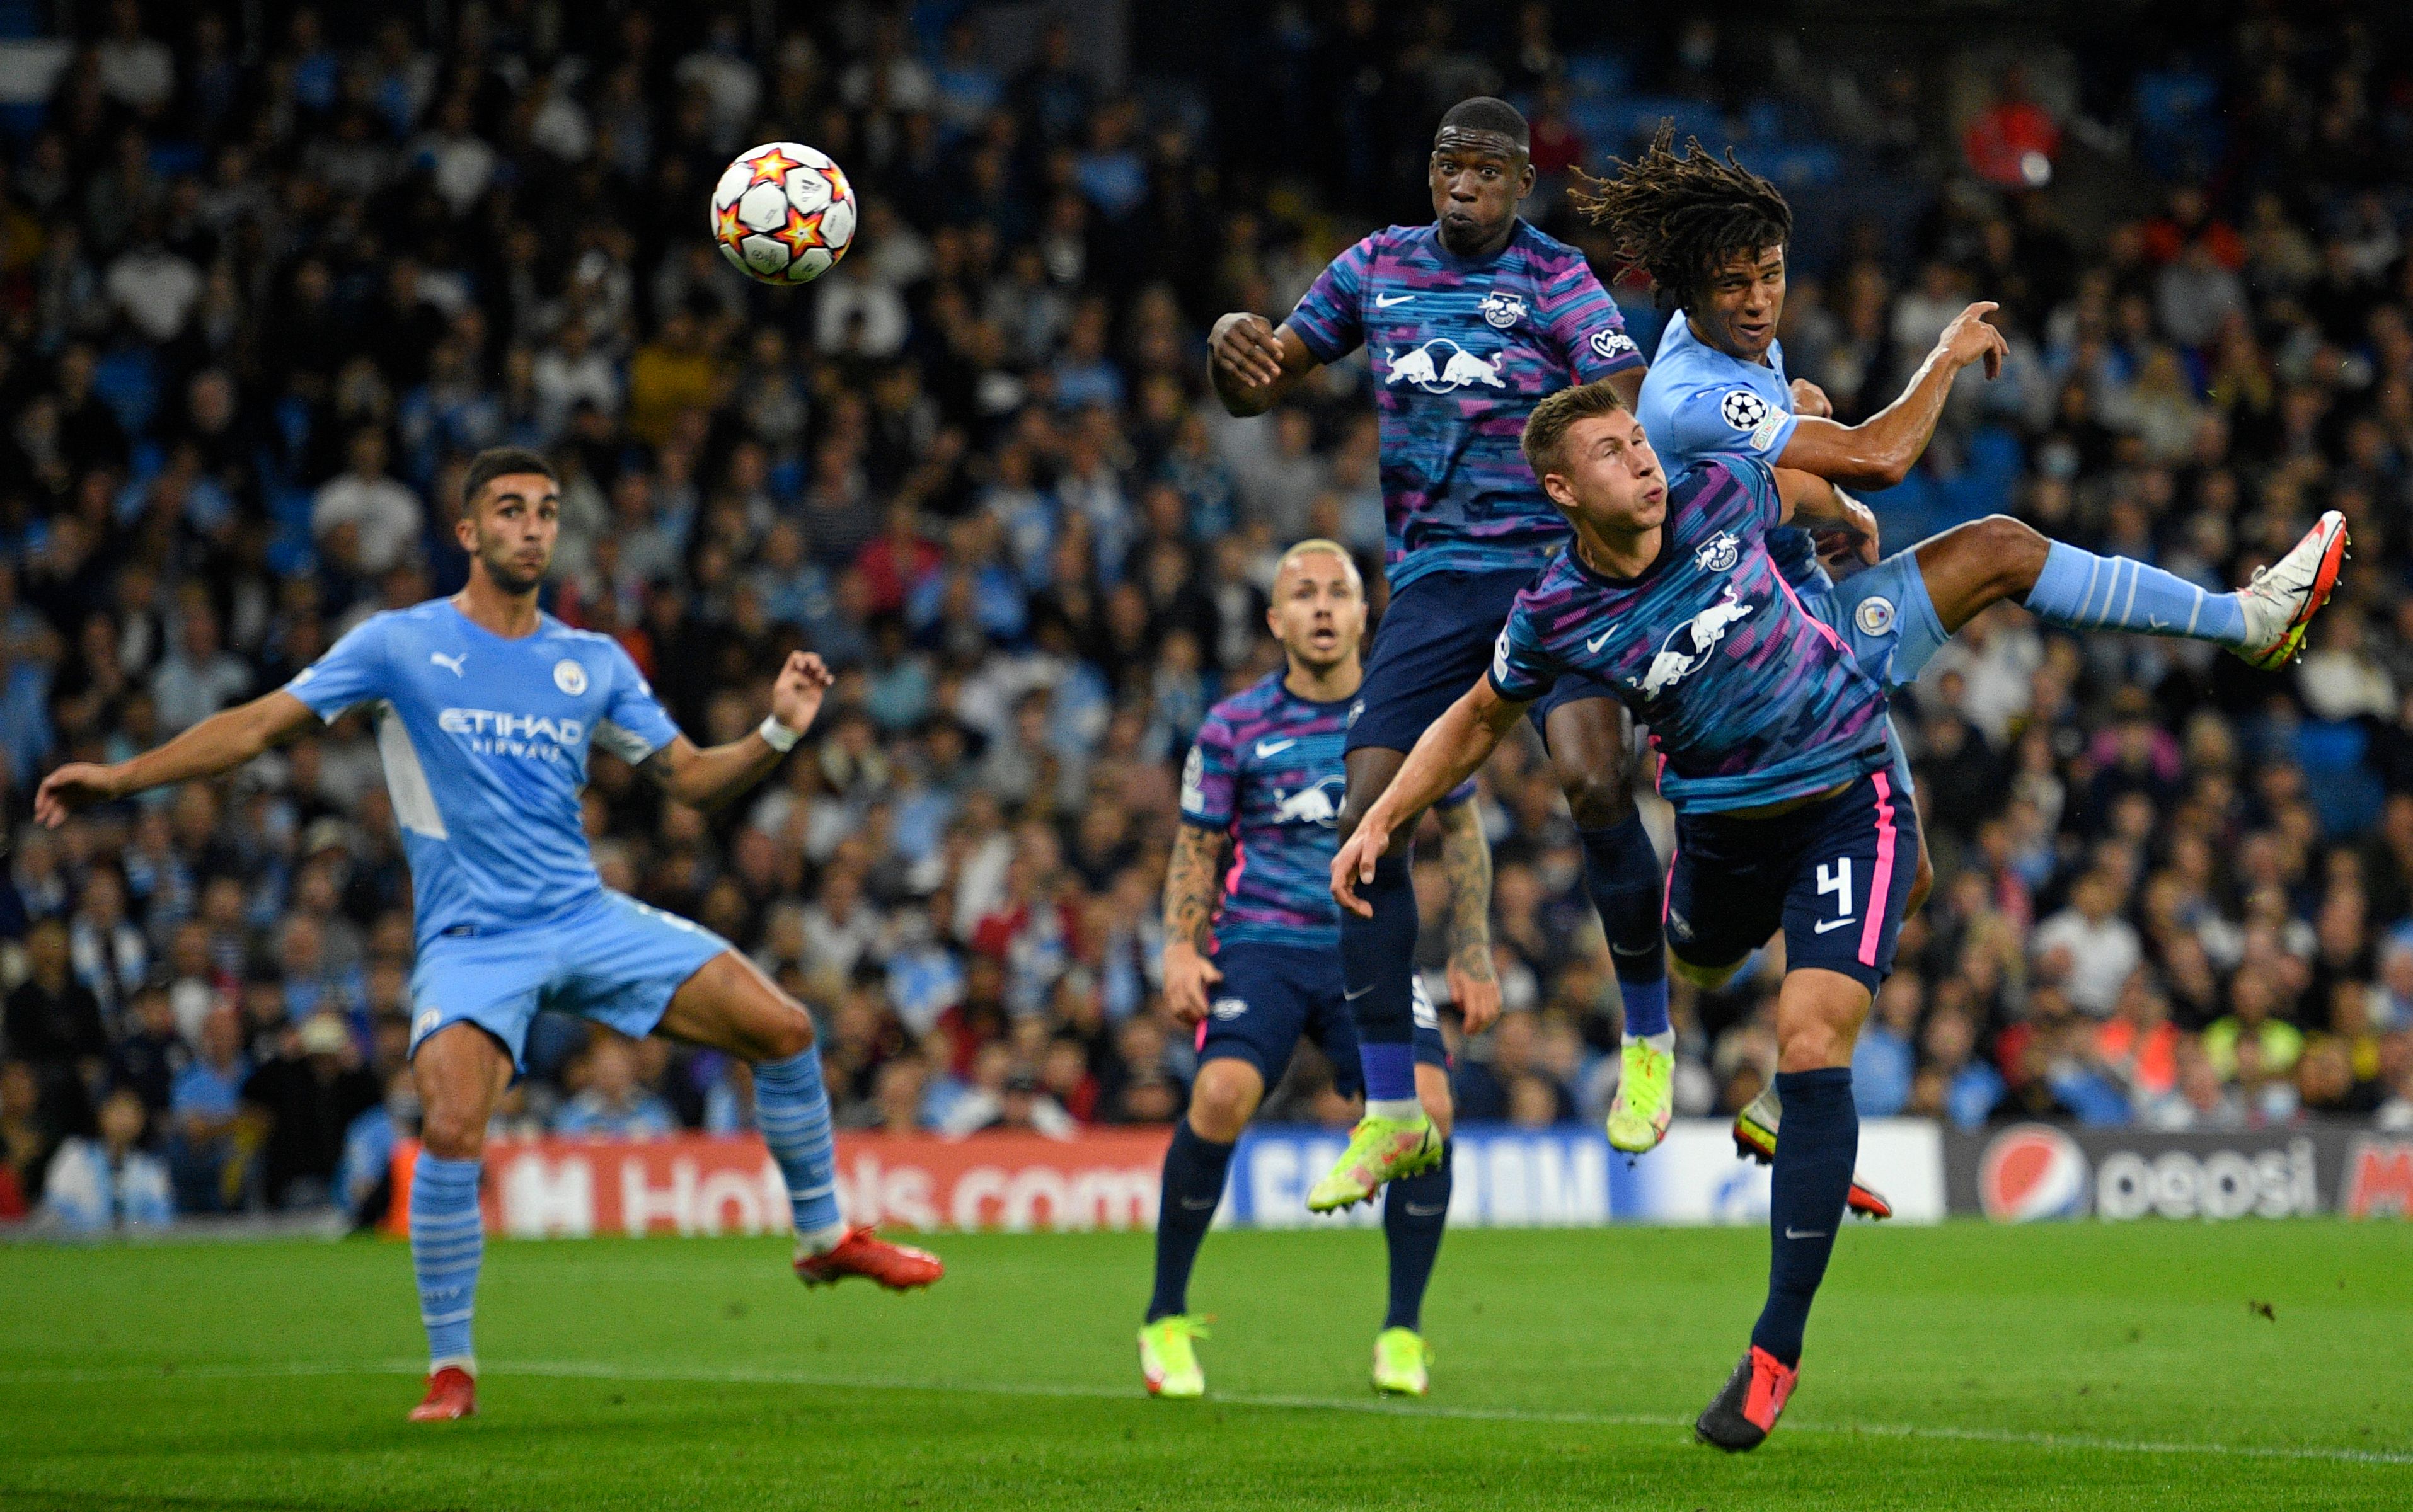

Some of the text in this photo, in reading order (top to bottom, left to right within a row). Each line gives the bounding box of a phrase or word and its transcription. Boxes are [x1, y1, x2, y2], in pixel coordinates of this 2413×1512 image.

[439, 707, 584, 746] ETIHAD
[1816, 857, 1852, 917] 4
[2097, 1136, 2318, 1224] pepsi
